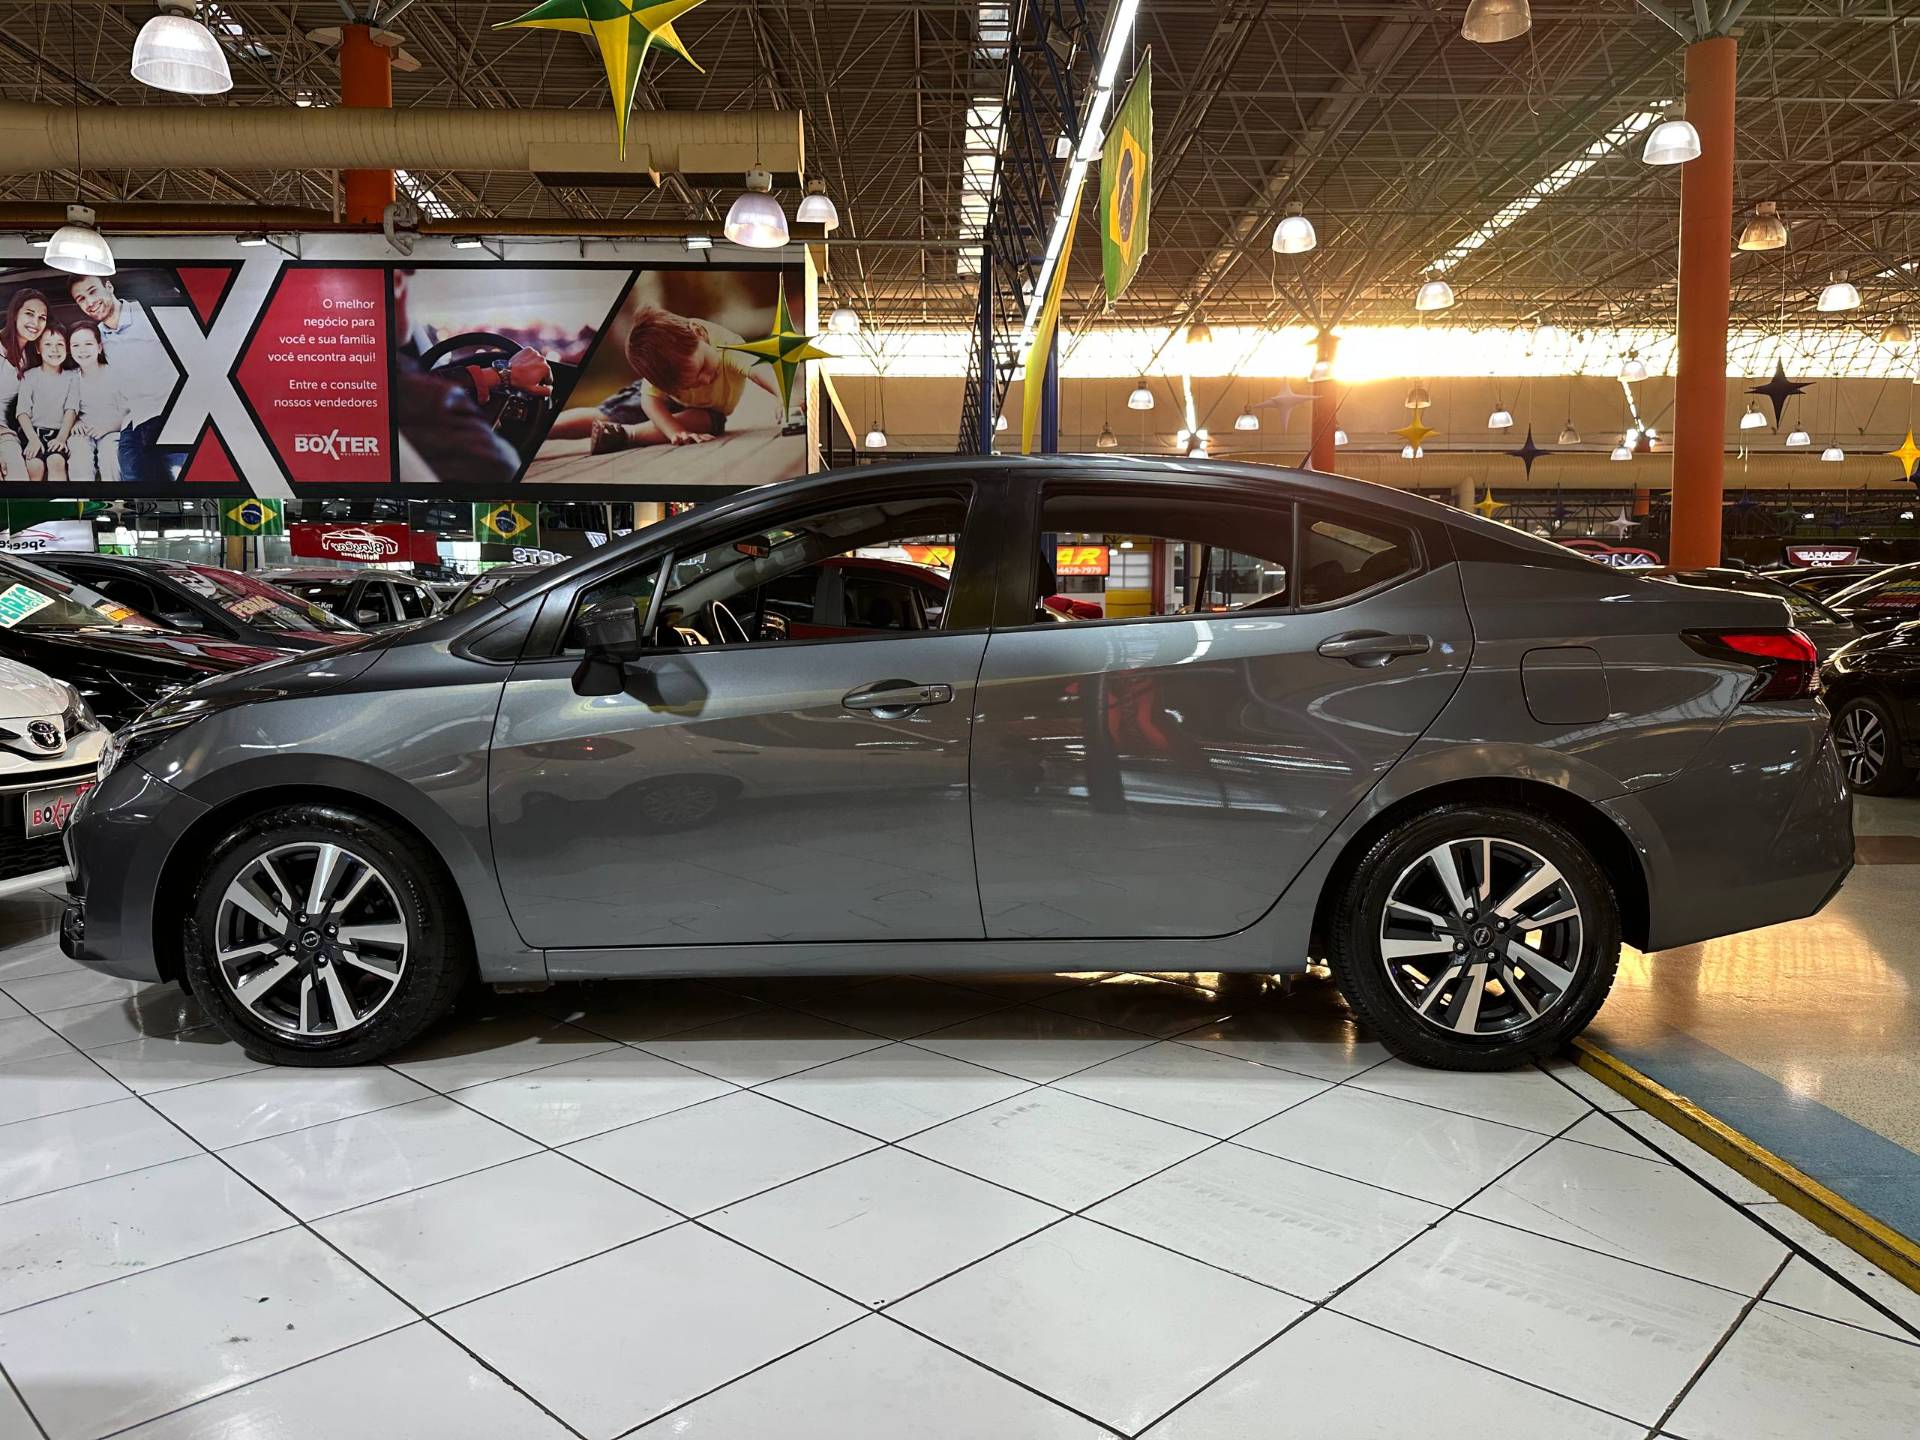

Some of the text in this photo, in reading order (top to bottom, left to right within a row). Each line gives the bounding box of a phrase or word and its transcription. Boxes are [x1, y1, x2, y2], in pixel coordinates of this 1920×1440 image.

[322, 299, 375, 309] O melhor
[303, 316, 375, 328] negócio para
[279, 334, 376, 345] você e sua família
[267, 352, 376, 364] você encontra aqui!
[288, 379, 377, 390] Entre e consulte
[273, 397, 378, 408] nossos vendedores
[294, 429, 379, 460] BOXTER
